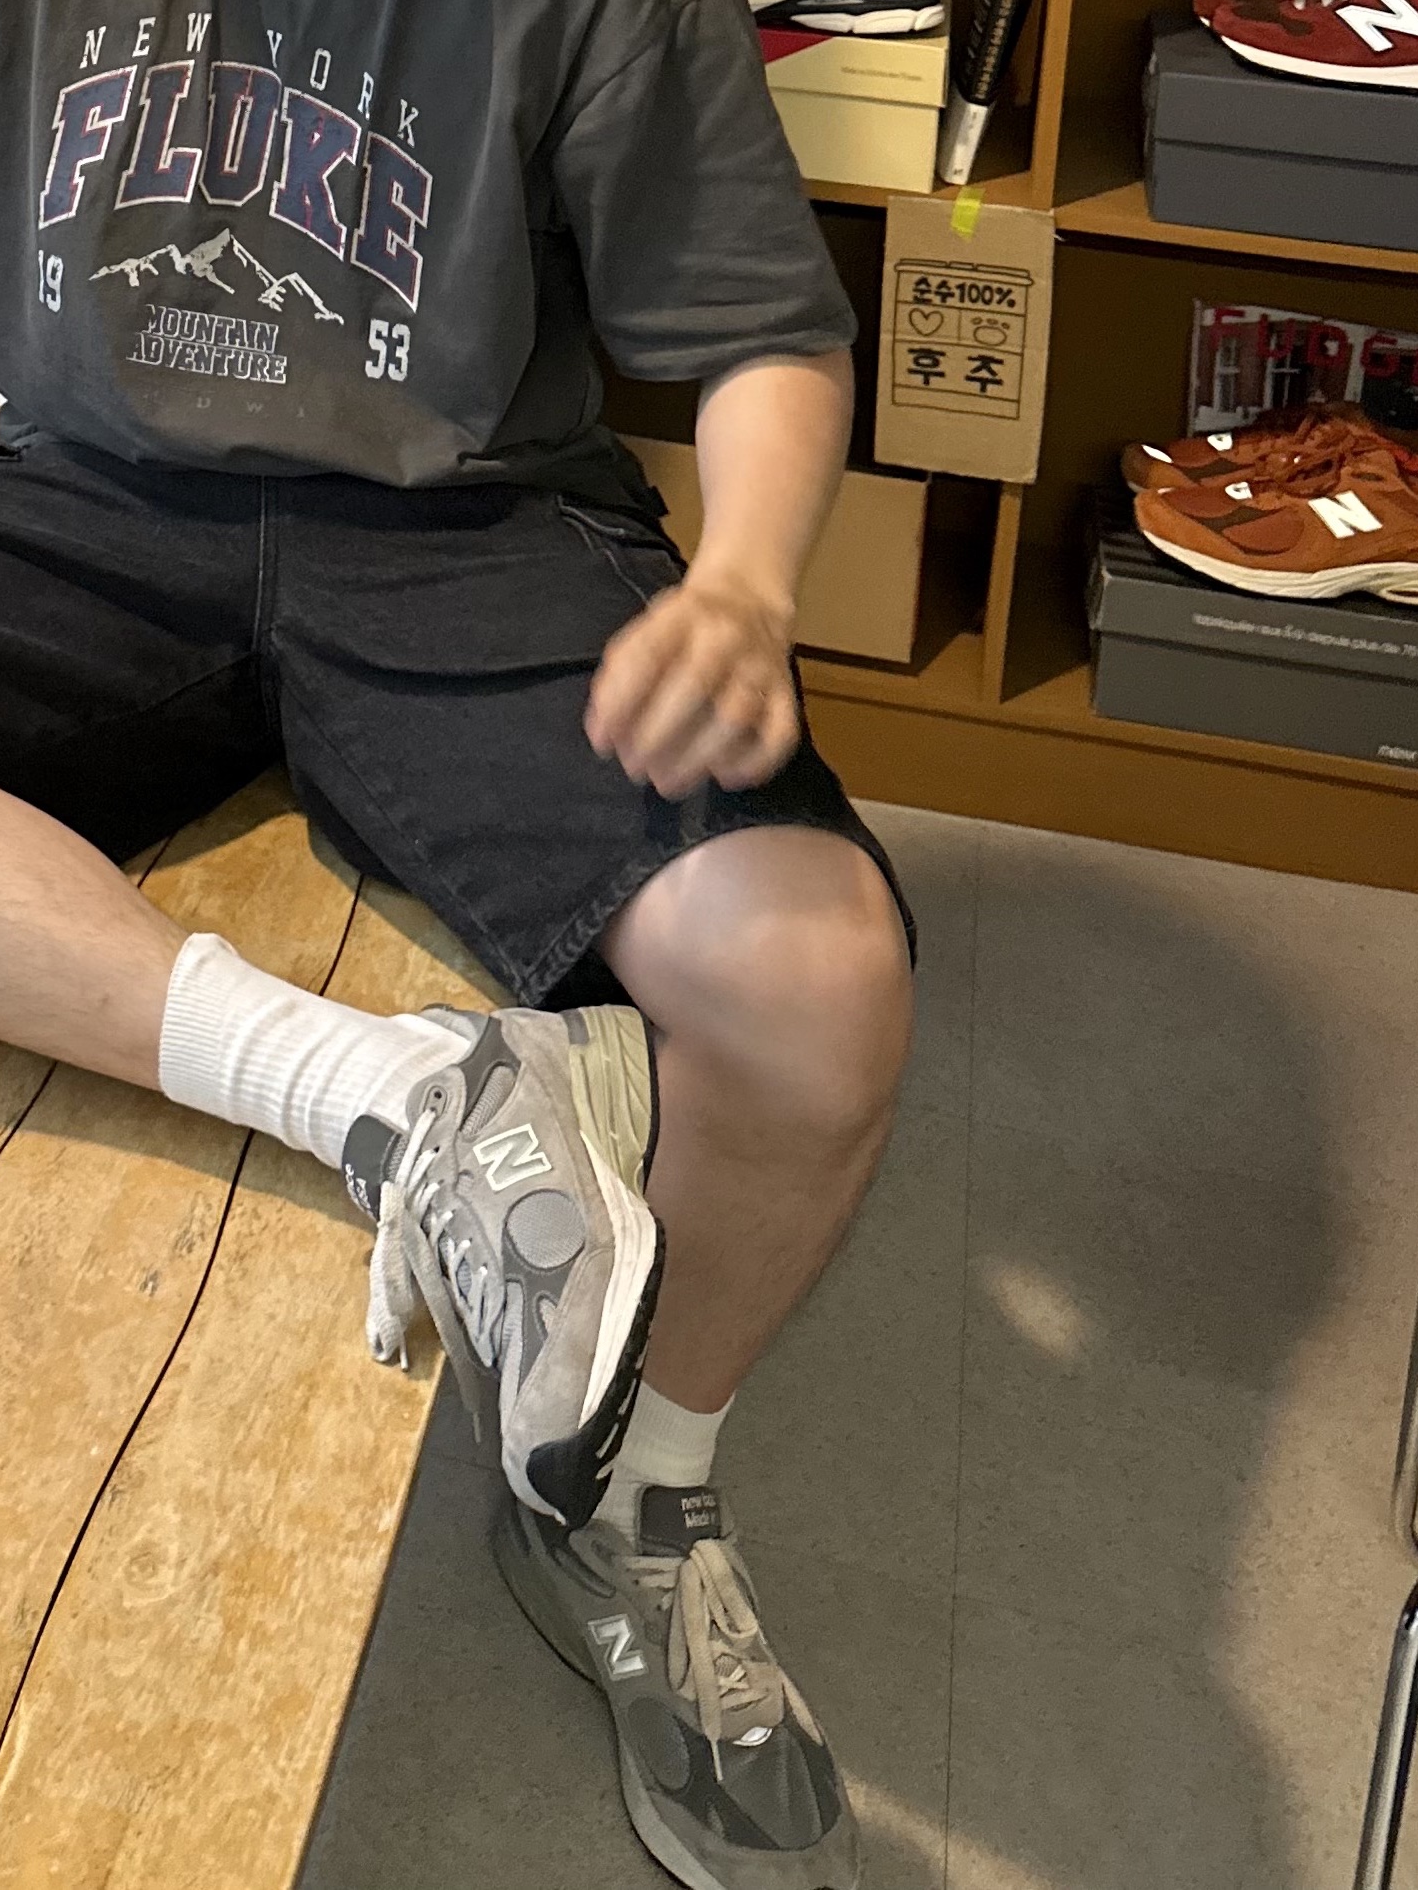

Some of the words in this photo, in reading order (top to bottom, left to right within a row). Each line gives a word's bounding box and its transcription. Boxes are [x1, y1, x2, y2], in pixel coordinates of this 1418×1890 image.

[80, 13, 212, 69] NEW
[266, 29, 420, 148] YORK
[39, 59, 433, 313] FLUKE
[38, 249, 64, 312] 19
[365, 319, 411, 382] 53
[144, 304, 280, 353] MOUNTAIN
[913, 276, 1017, 309] 순수100%
[126, 332, 288, 385] ADVENTURE
[1208, 307, 1418, 386] FUDG
